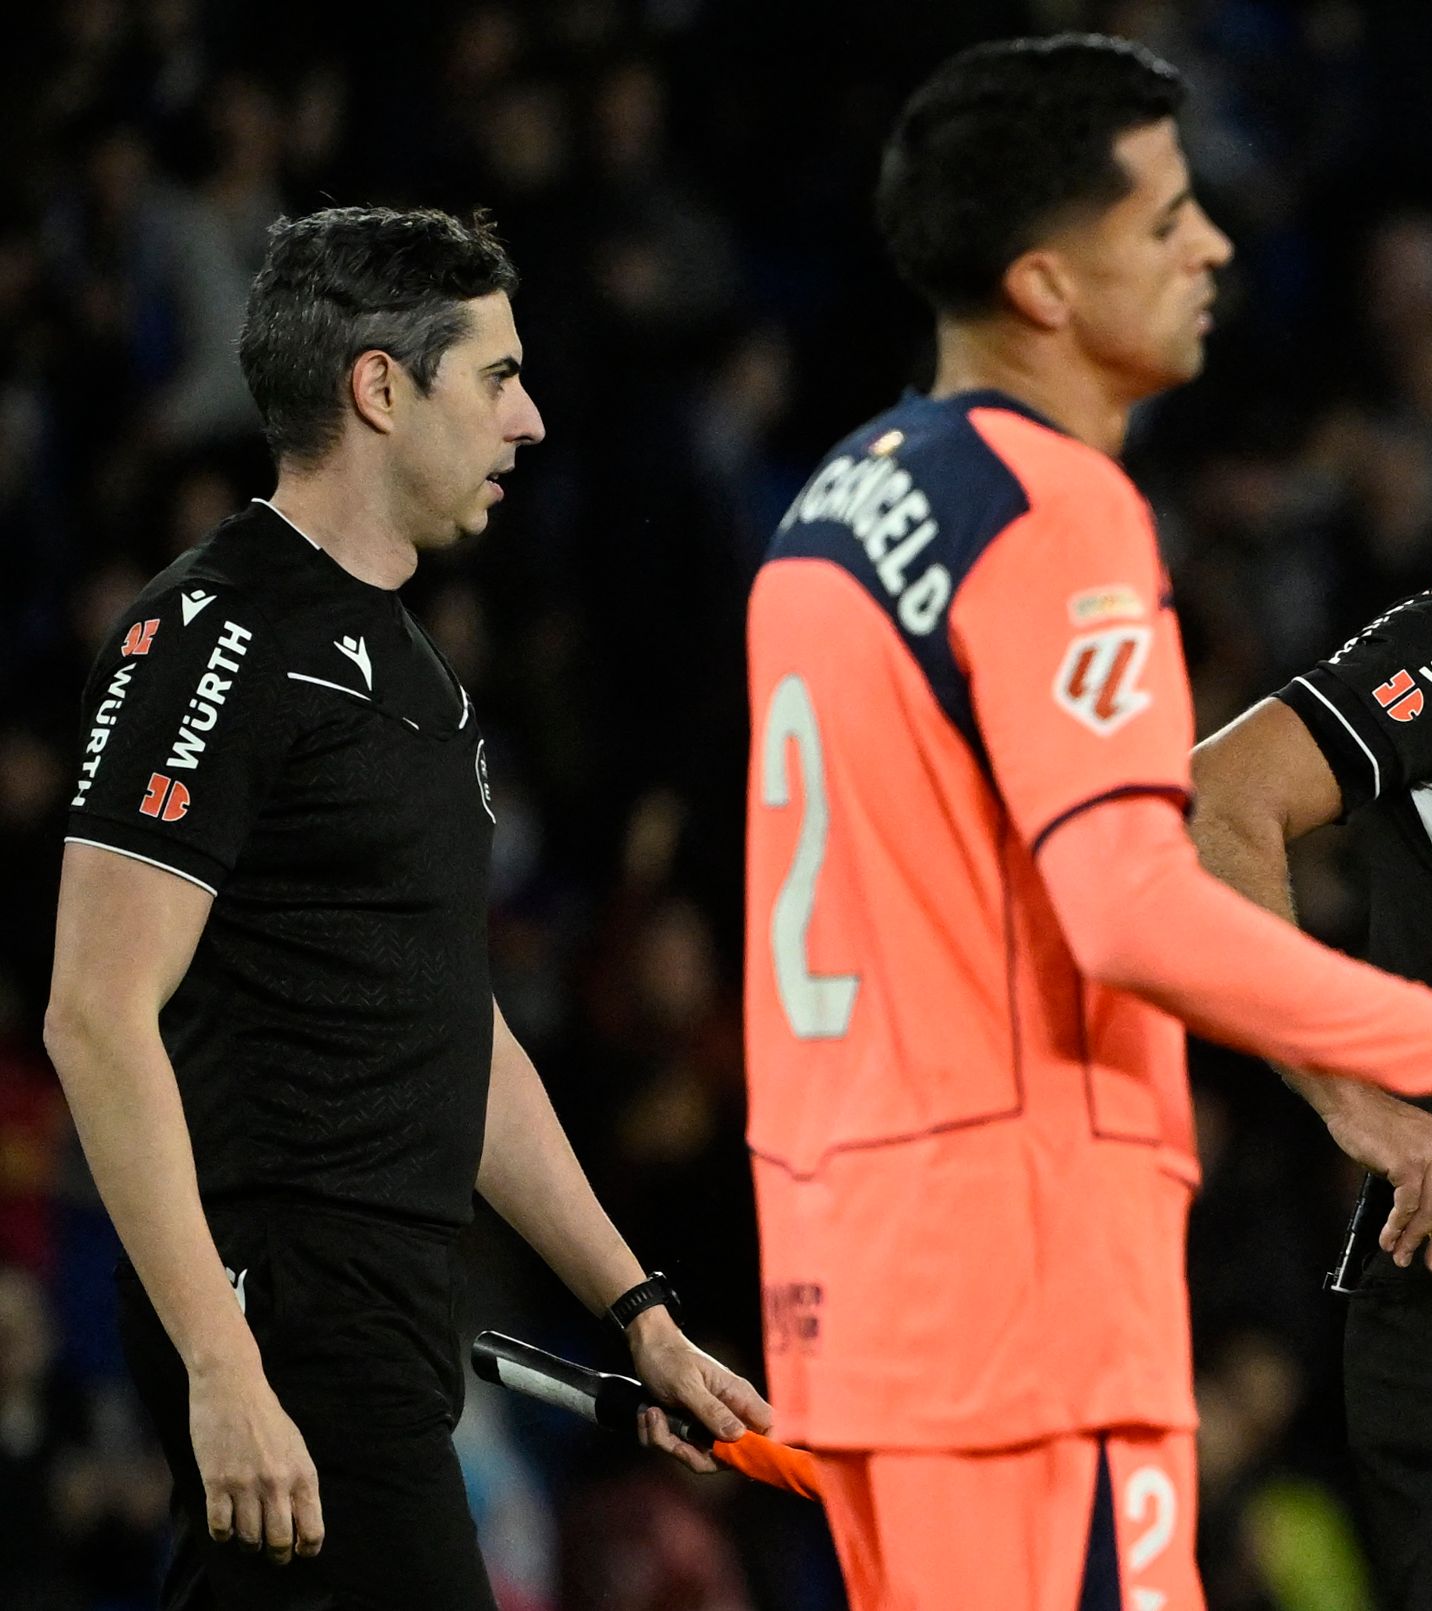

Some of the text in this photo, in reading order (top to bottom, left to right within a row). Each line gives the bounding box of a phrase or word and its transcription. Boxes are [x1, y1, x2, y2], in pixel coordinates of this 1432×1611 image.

[71, 662, 137, 806] WÜRTH
[165, 620, 252, 770] WÜRTH
[763, 673, 860, 1038] 2
